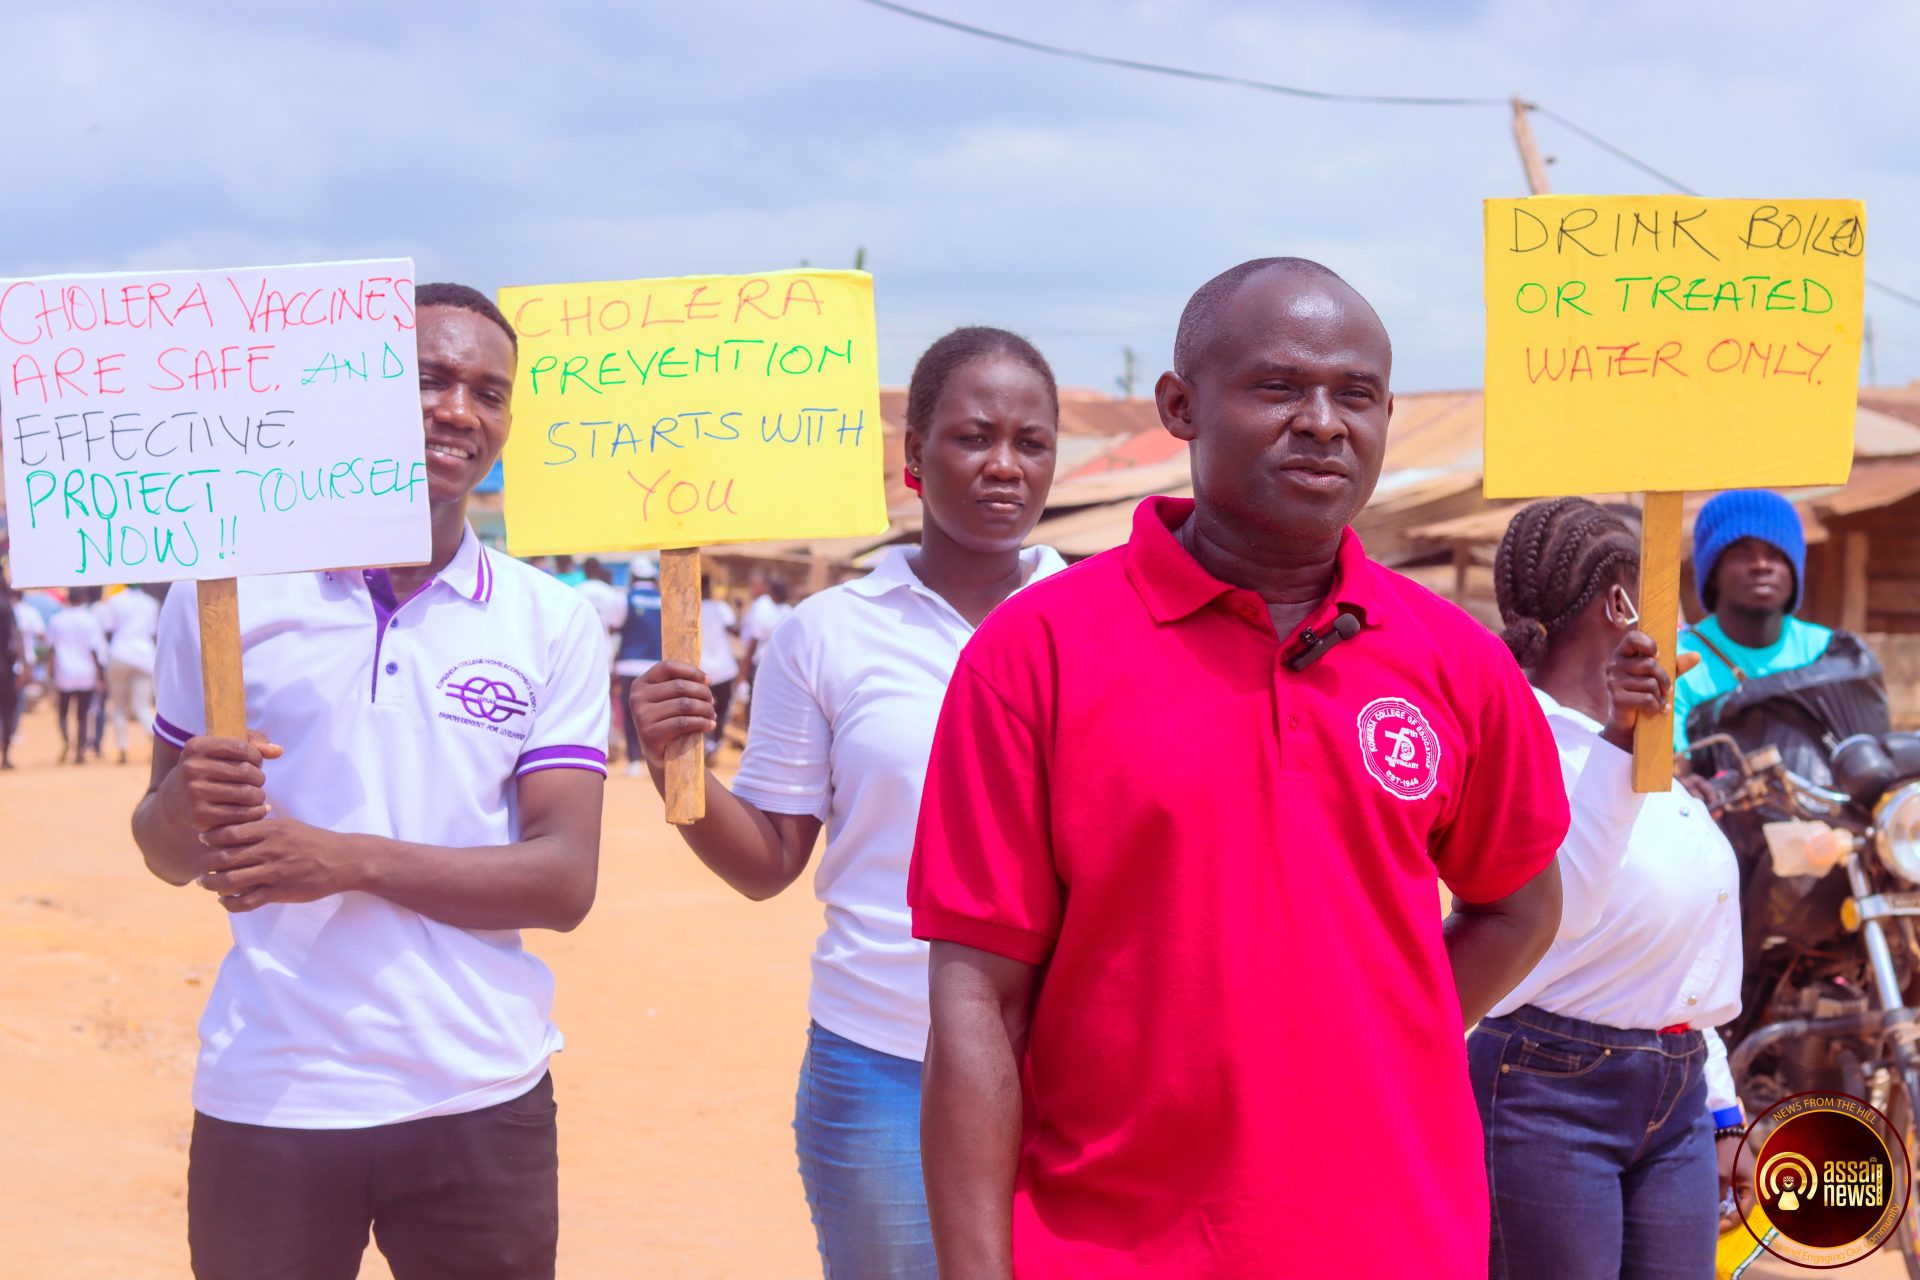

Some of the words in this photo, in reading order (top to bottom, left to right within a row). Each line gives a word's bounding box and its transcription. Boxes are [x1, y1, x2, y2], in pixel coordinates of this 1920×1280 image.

[1510, 207, 1720, 261] DRINK
[1739, 205, 1864, 257] BOILED
[0, 281, 213, 344] CHOLERA
[227, 277, 416, 333] VACCINES
[514, 279, 825, 338] CHOLERA
[1516, 281, 1593, 317] OR
[1615, 275, 1833, 314] TREATED
[12, 347, 126, 402] ARE
[301, 342, 404, 385] AND
[530, 340, 853, 395] PREVENTION
[1526, 341, 1689, 384] WATER
[1707, 338, 1832, 385] ONLY.
[544, 411, 743, 465] STARTS
[761, 408, 864, 447] WITH
[26, 469, 220, 528] PROTECT
[235, 457, 427, 512] YOURSELF
[627, 469, 738, 522] YOU
[1374, 708, 1406, 721] COLLEGE
[1407, 716, 1418, 726] OF
